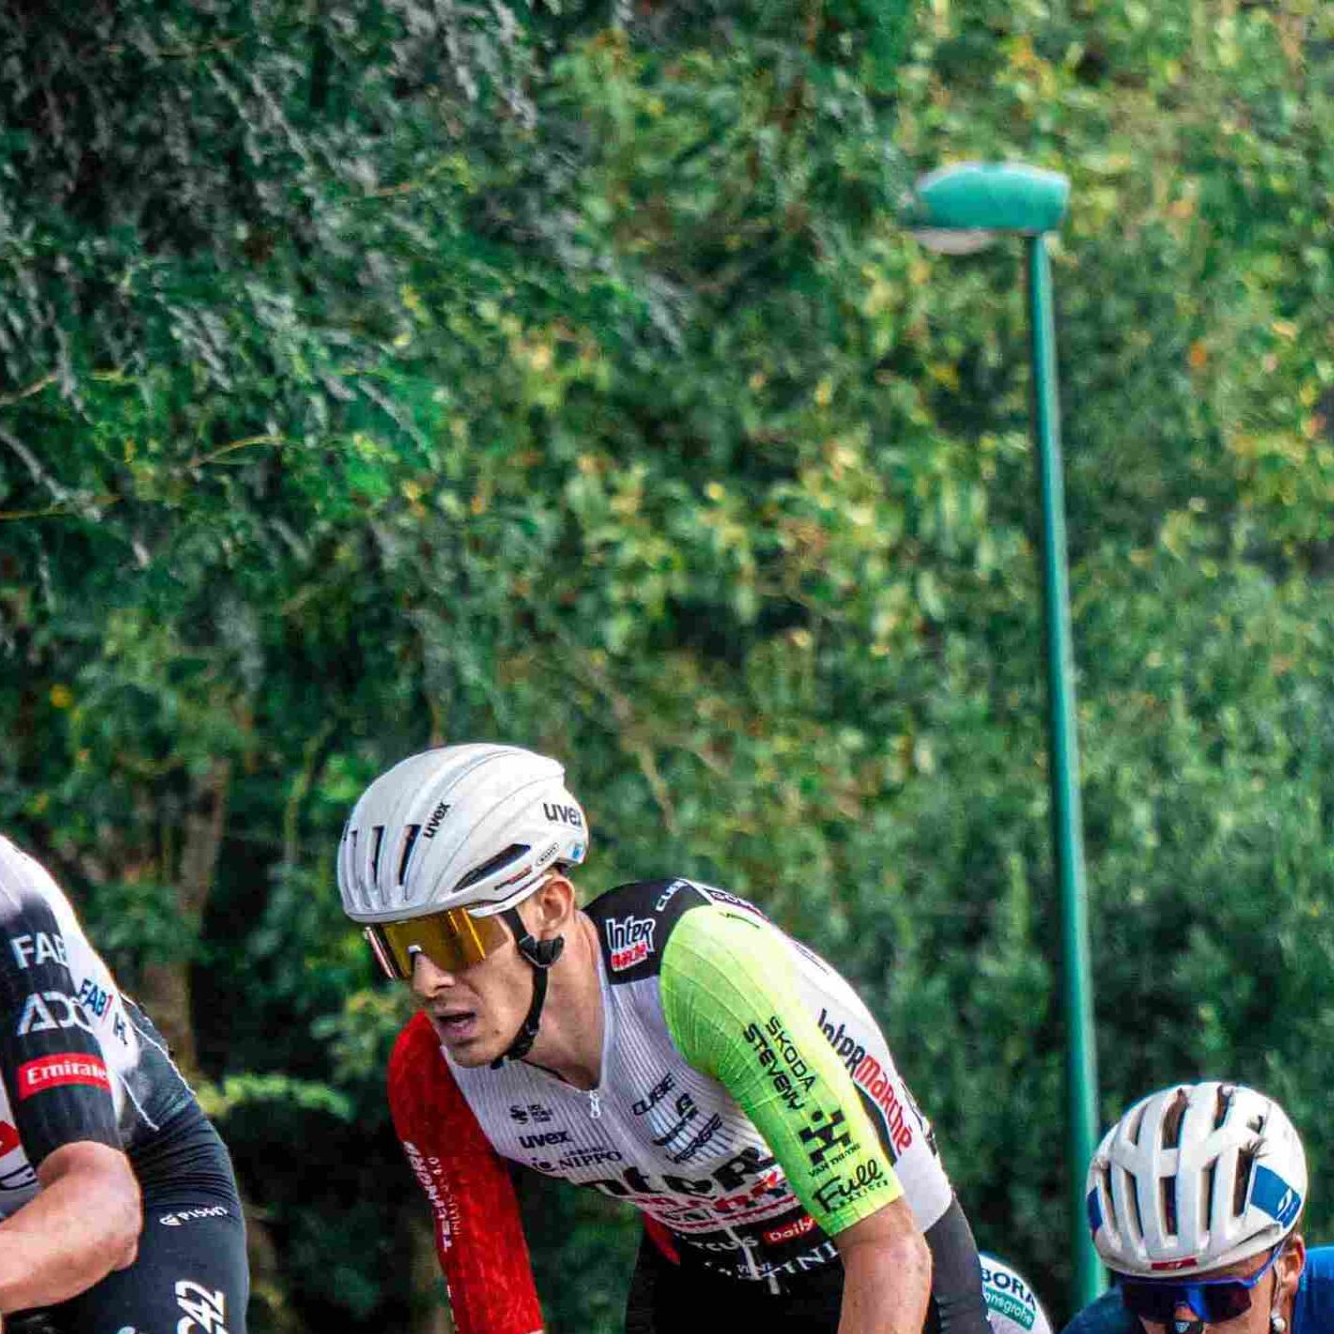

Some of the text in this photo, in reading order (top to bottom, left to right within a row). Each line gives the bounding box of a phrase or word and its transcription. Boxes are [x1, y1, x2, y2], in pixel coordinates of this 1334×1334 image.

[423, 800, 452, 840] uvex
[27, 1062, 109, 1085] Emirate
[743, 1023, 806, 1111] STEVENY
[518, 1130, 574, 1149] uvex
[558, 1150, 623, 1171] NIPPO
[811, 1158, 884, 1214] Full
